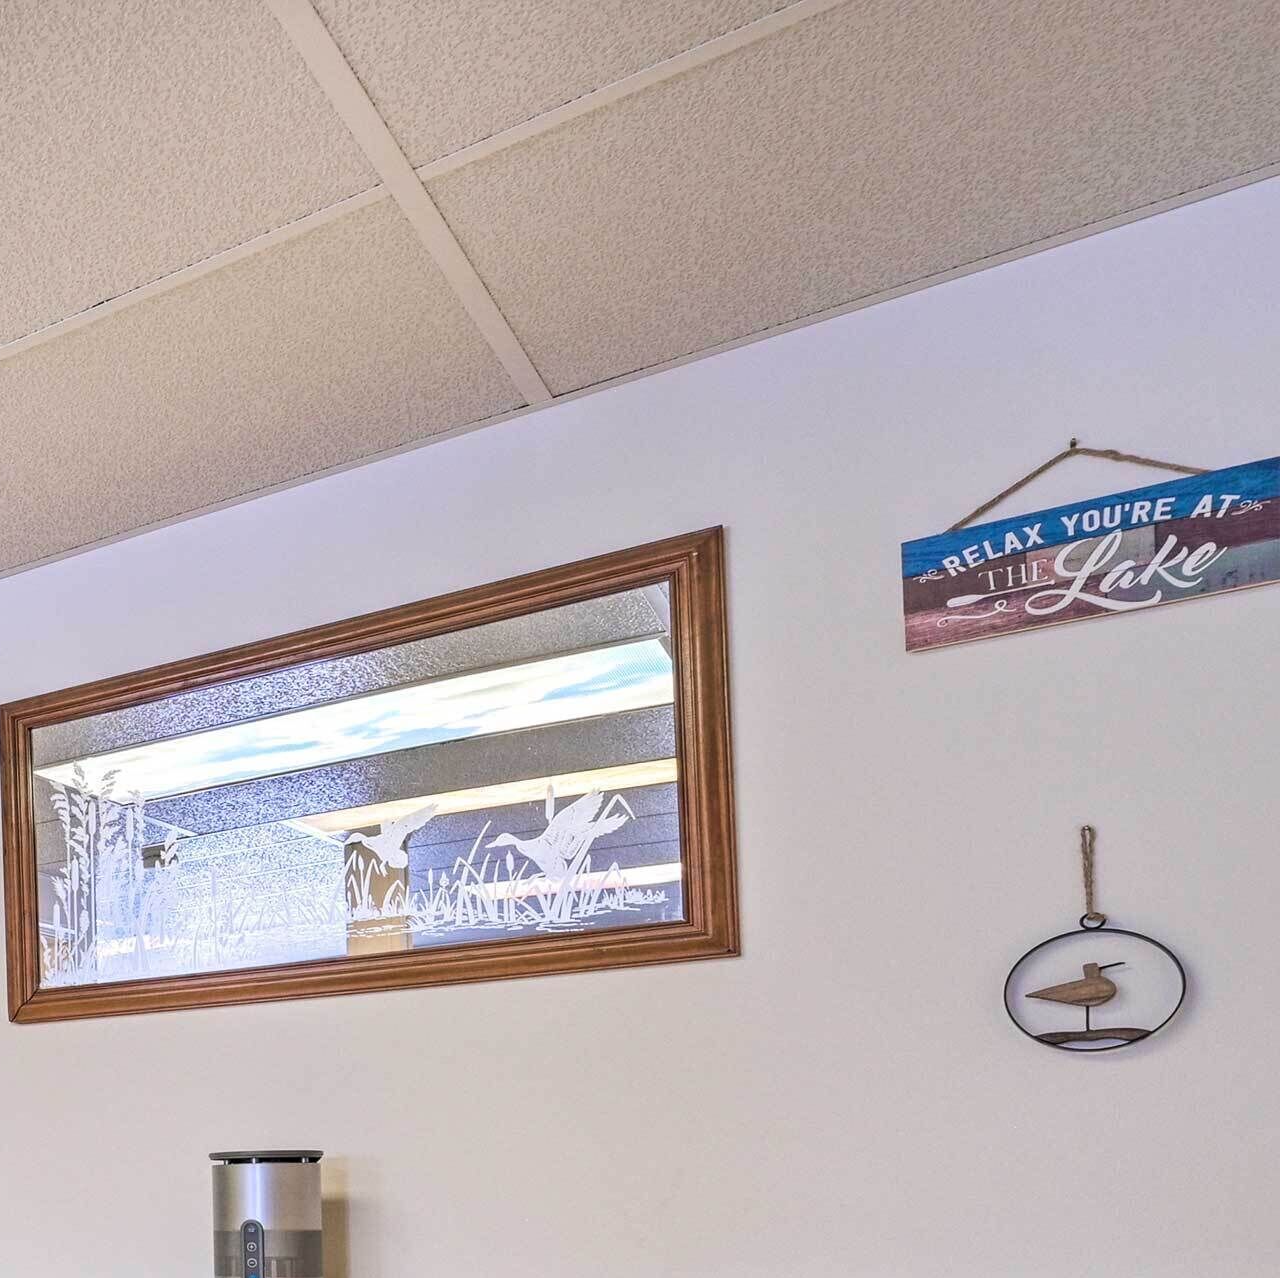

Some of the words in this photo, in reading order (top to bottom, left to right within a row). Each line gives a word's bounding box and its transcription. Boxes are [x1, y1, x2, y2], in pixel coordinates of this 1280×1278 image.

[942, 523, 1044, 577] RELAX
[1060, 496, 1176, 537] YOU'RE
[1190, 494, 1241, 519] AT
[978, 558, 1053, 591] THE
[1024, 528, 1228, 616] Lake
